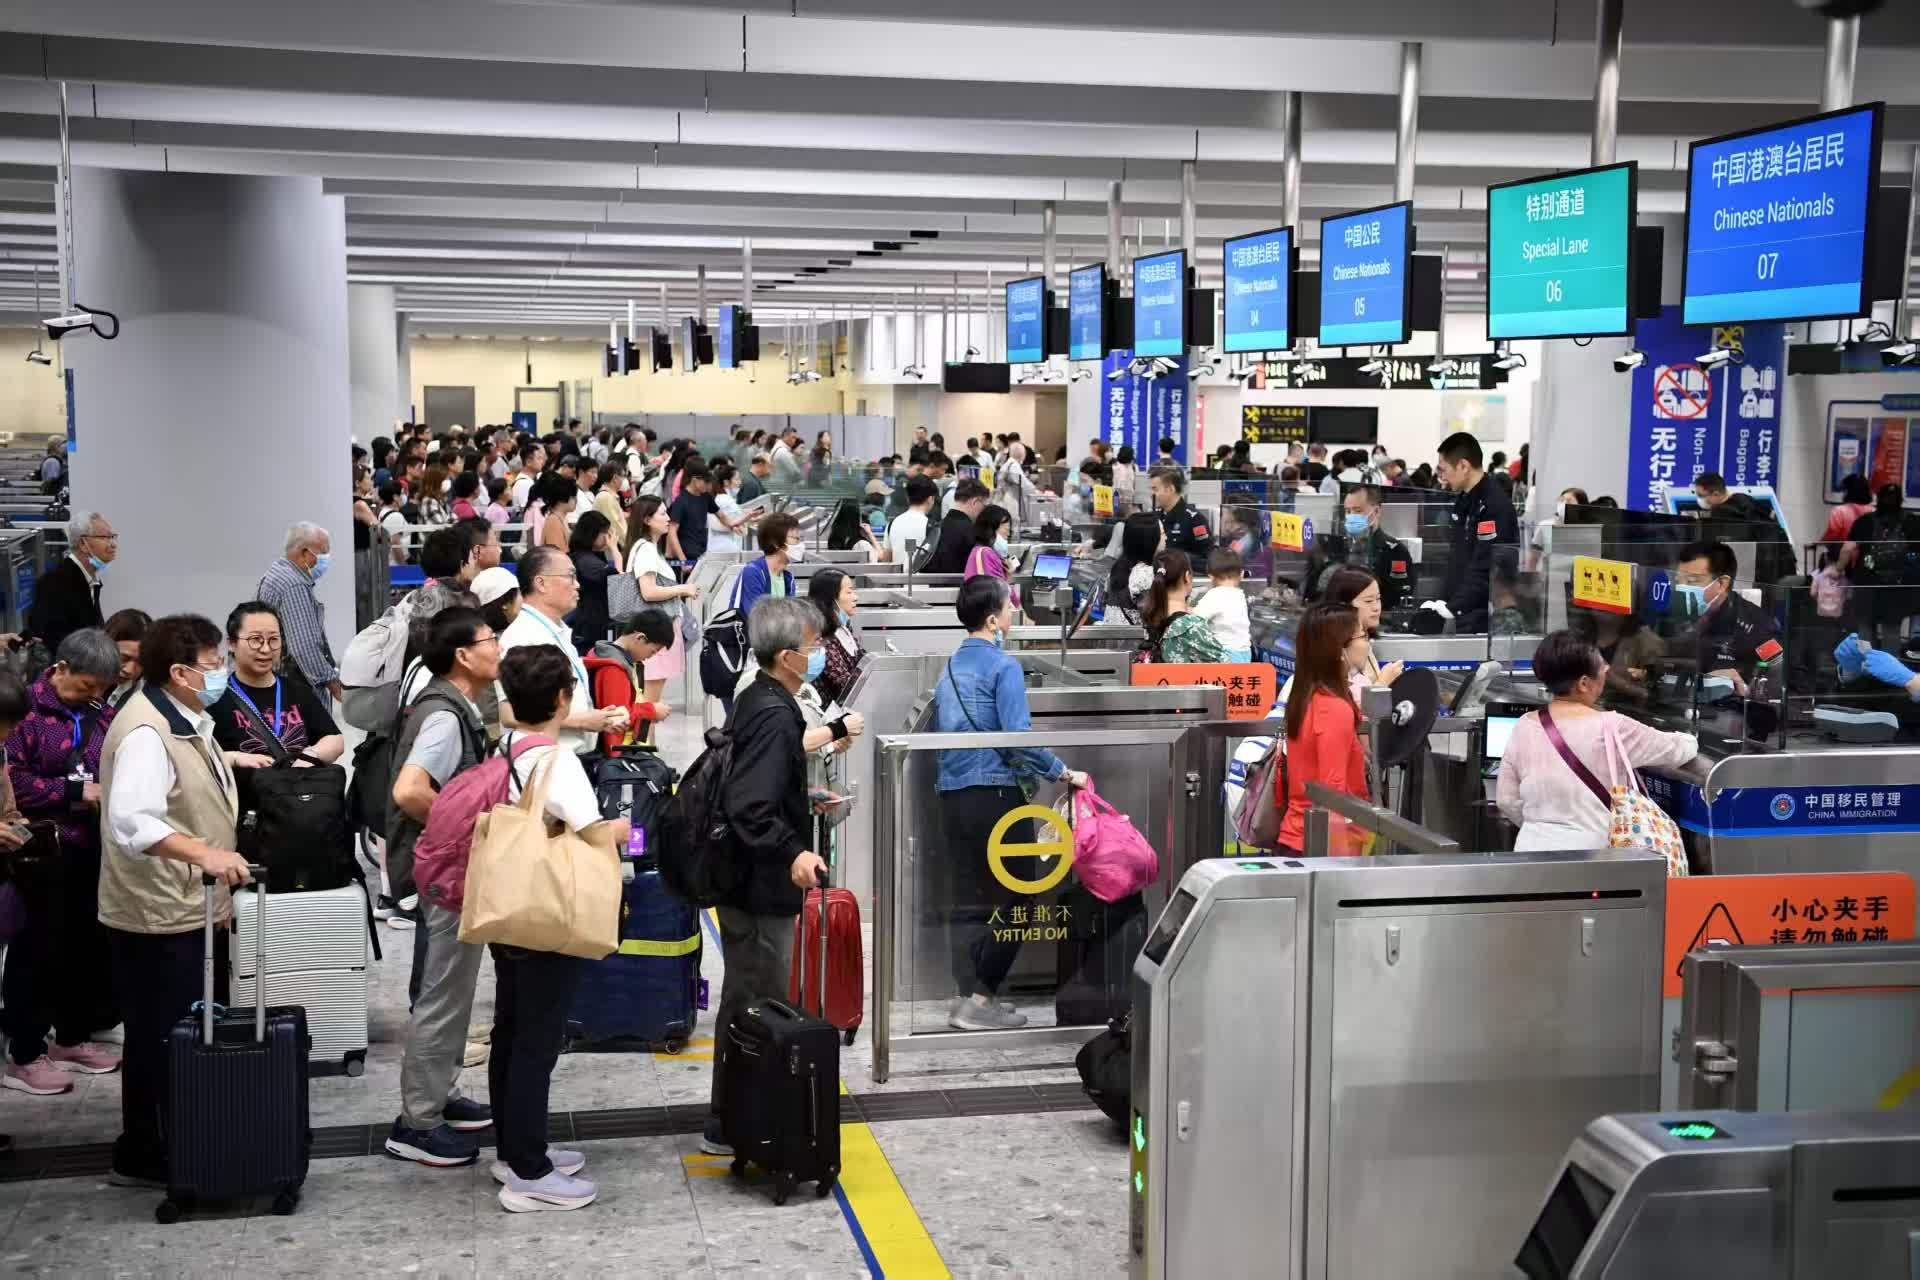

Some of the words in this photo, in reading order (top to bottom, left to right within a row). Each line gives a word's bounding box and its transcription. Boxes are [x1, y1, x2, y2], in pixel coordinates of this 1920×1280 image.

[1712, 132, 1844, 189] 中国港澳台居民
[1526, 188, 1585, 222] 特别通道
[1713, 205, 1764, 231] Chinese
[1768, 194, 1834, 223] Nationals
[1344, 221, 1381, 249] 中国公民
[1522, 239, 1559, 264] Special
[1562, 236, 1589, 256] Lane
[1333, 264, 1358, 280] Chinese
[1359, 257, 1391, 277] Nationals
[1757, 253, 1778, 280] 07
[1546, 279, 1562, 302] 06
[1354, 297, 1365, 316] 05
[1648, 427, 1677, 512] 无行李
[1303, 525, 1312, 540] 05
[1652, 581, 1668, 601] 07
[1228, 693, 1261, 707] 触碰
[1805, 792, 1901, 808] 中国移民管理
[1808, 811, 1835, 819] CHINA
[1840, 809, 1897, 818] IMMIGRATION
[1770, 896, 1889, 922] 小心夹手
